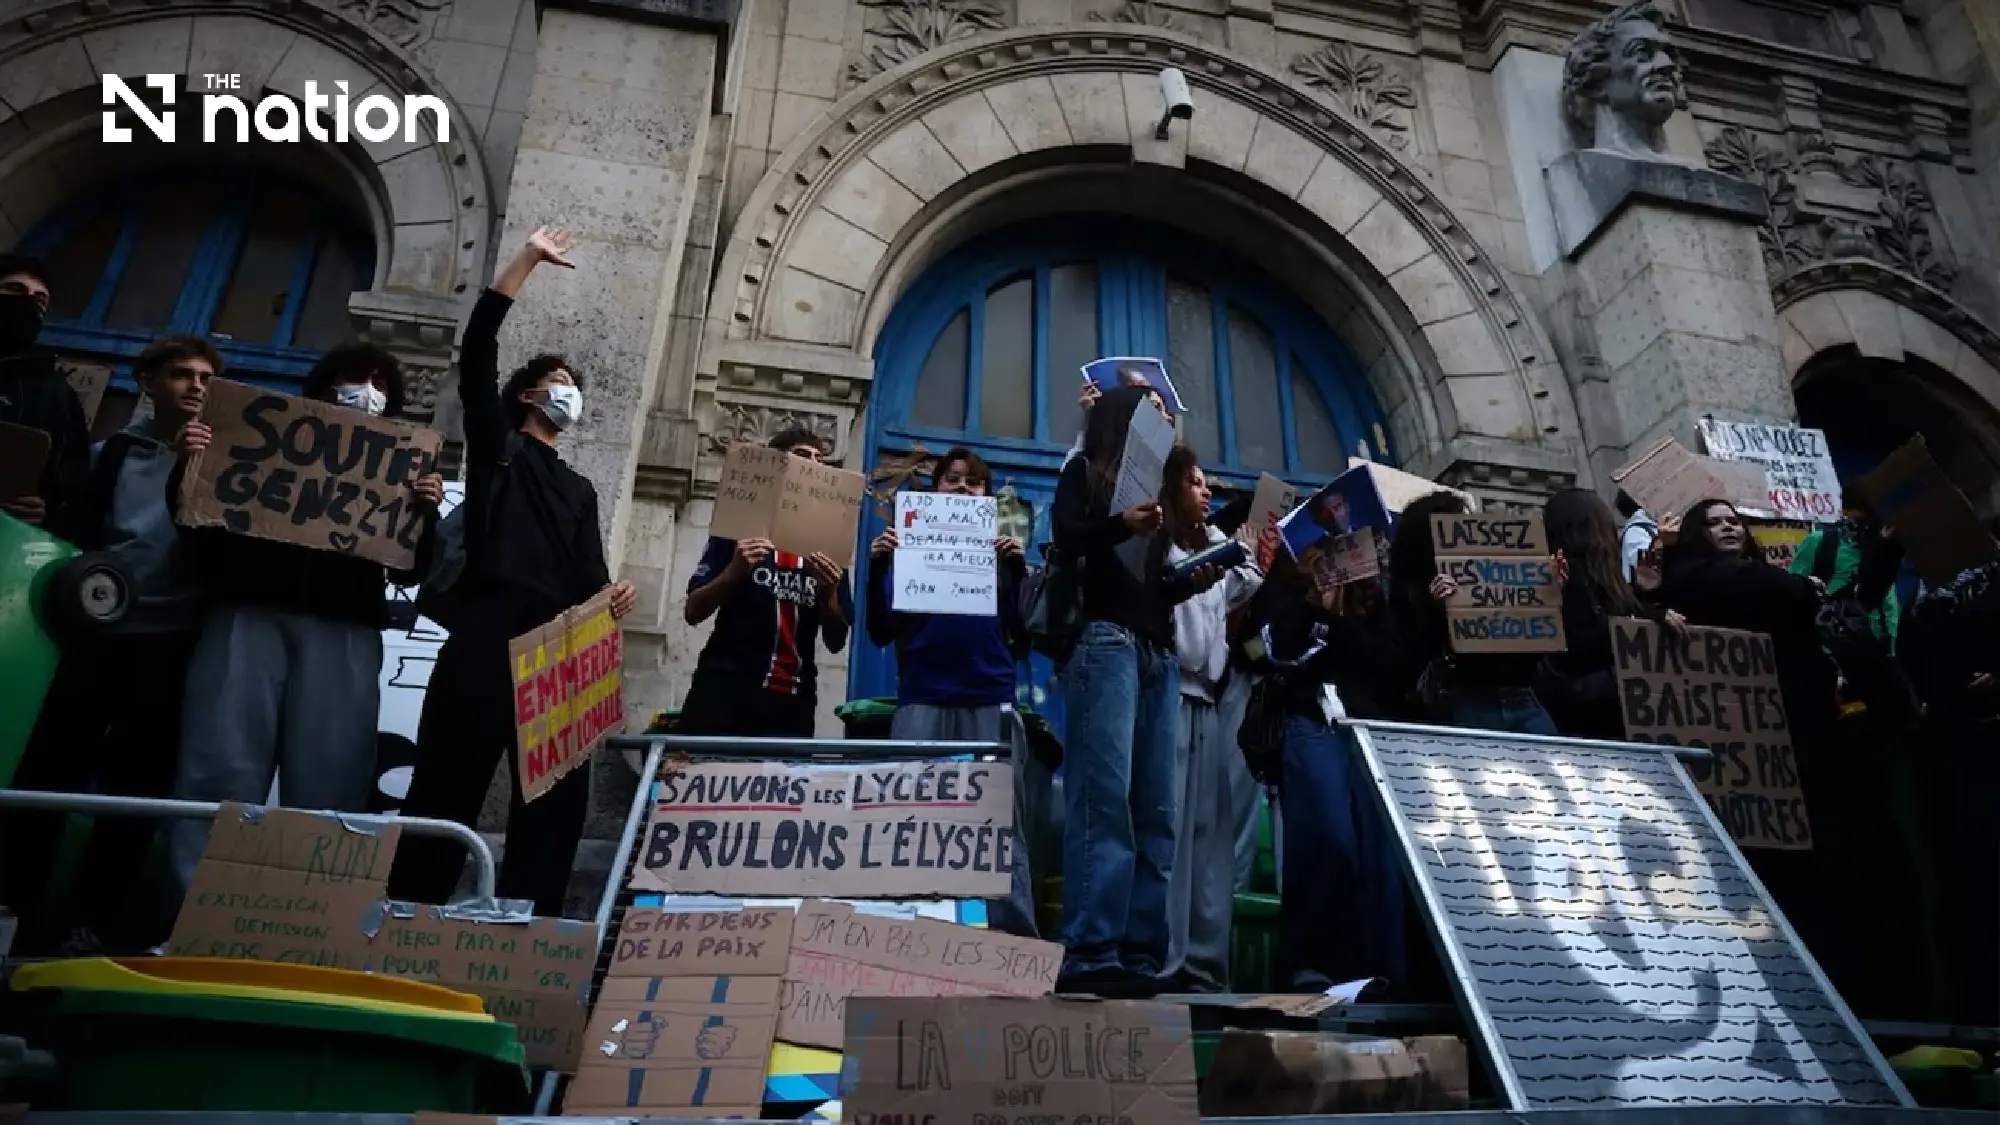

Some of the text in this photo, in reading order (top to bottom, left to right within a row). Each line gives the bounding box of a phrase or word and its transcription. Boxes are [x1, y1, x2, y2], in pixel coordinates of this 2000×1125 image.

[945, 497, 977, 508] TOUT
[904, 533, 959, 547] DEMAIN
[1437, 519, 1535, 549] LAISSEZ
[951, 552, 995, 567] MIEUX
[754, 567, 818, 595] QATAR
[1471, 587, 1543, 607] SAUVER
[1616, 625, 1776, 677] MACRON
[517, 628, 621, 725] EMMERDE
[1755, 742, 1799, 789] PAS
[656, 765, 990, 806] SAUVONS LES LYCÉES
[645, 813, 1015, 873] BRULONS L'ÉLYSÉE
[388, 926, 440, 950] MERCI
[616, 938, 652, 962] DE
[657, 938, 684, 960] LA
[382, 955, 441, 979] POUR
[467, 962, 509, 981] MAI
[886, 924, 931, 958] BAS
[942, 937, 984, 967] LES
[993, 944, 1056, 984] STEAK
[896, 1020, 952, 1092] LA
